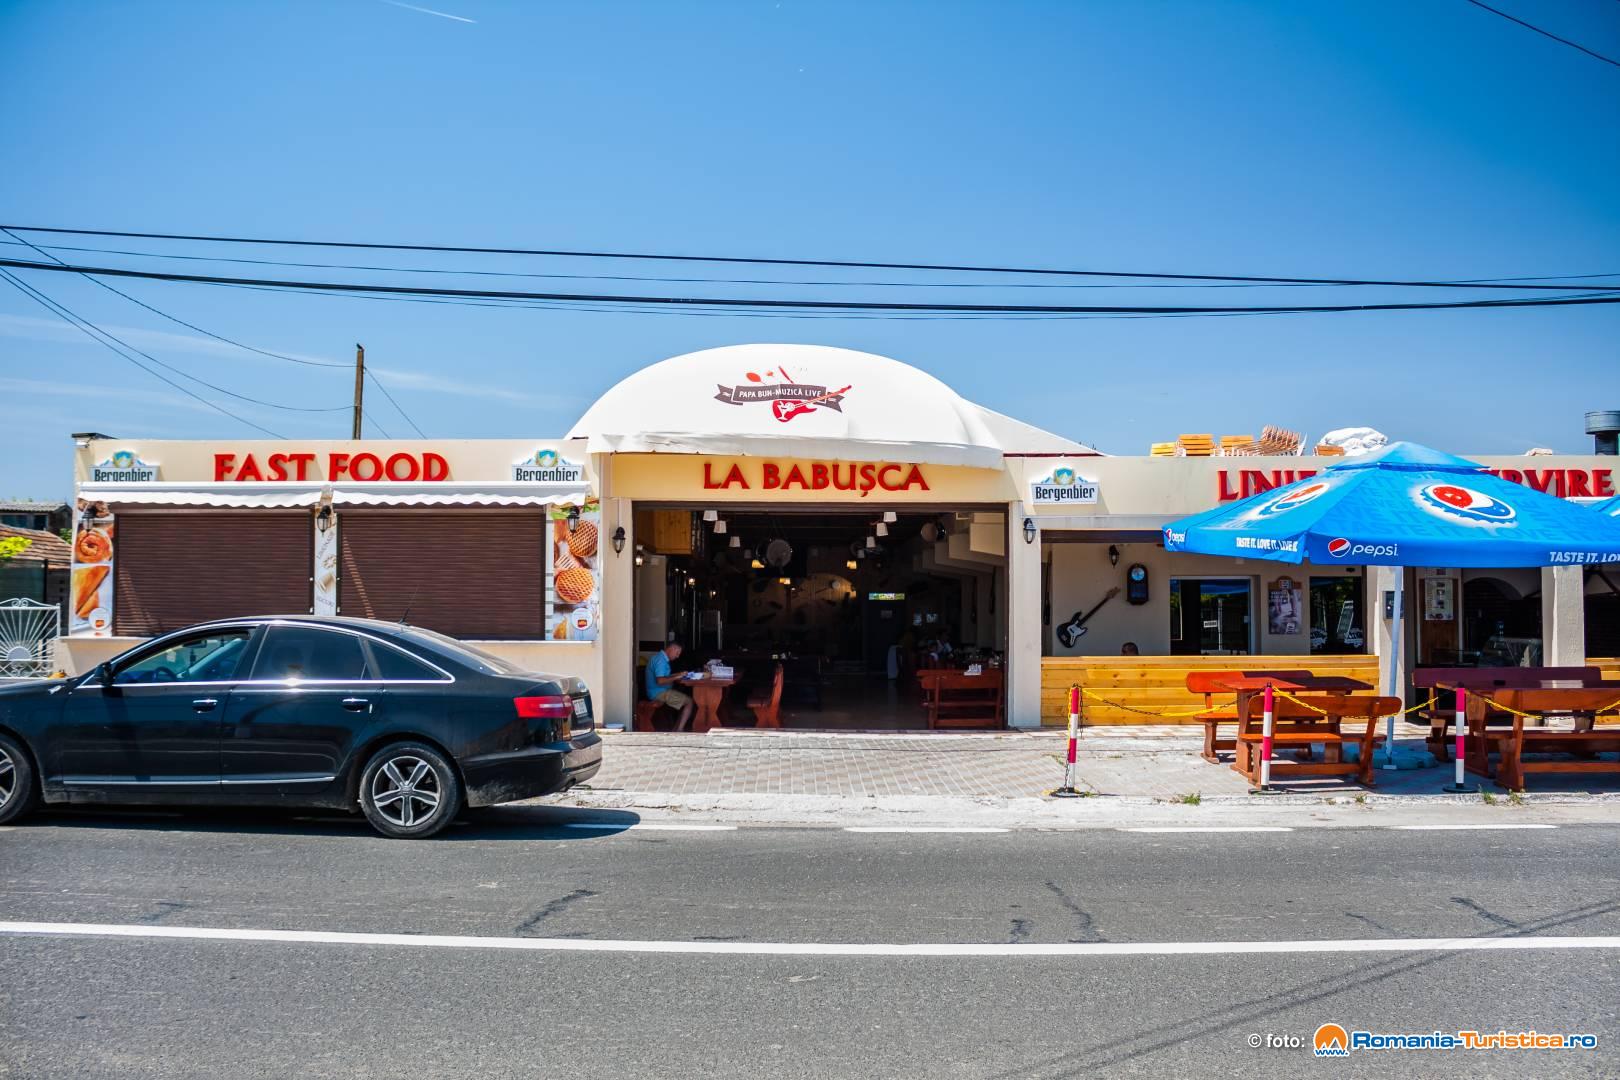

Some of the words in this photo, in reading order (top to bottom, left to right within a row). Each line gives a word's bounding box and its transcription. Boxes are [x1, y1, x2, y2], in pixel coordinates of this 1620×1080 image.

[738, 390, 756, 399] PAPA
[804, 388, 822, 398] LIVE
[214, 453, 316, 482] FAST
[328, 452, 449, 482] FOOD
[515, 467, 579, 482] Bergenbier
[94, 468, 153, 482] Bergenbier
[703, 463, 751, 490] LA
[1035, 484, 1095, 502] Bergenbier
[1217, 470, 1317, 501] LIN
[1351, 543, 1397, 558] pepsi
[1549, 551, 1585, 563] TASTE
